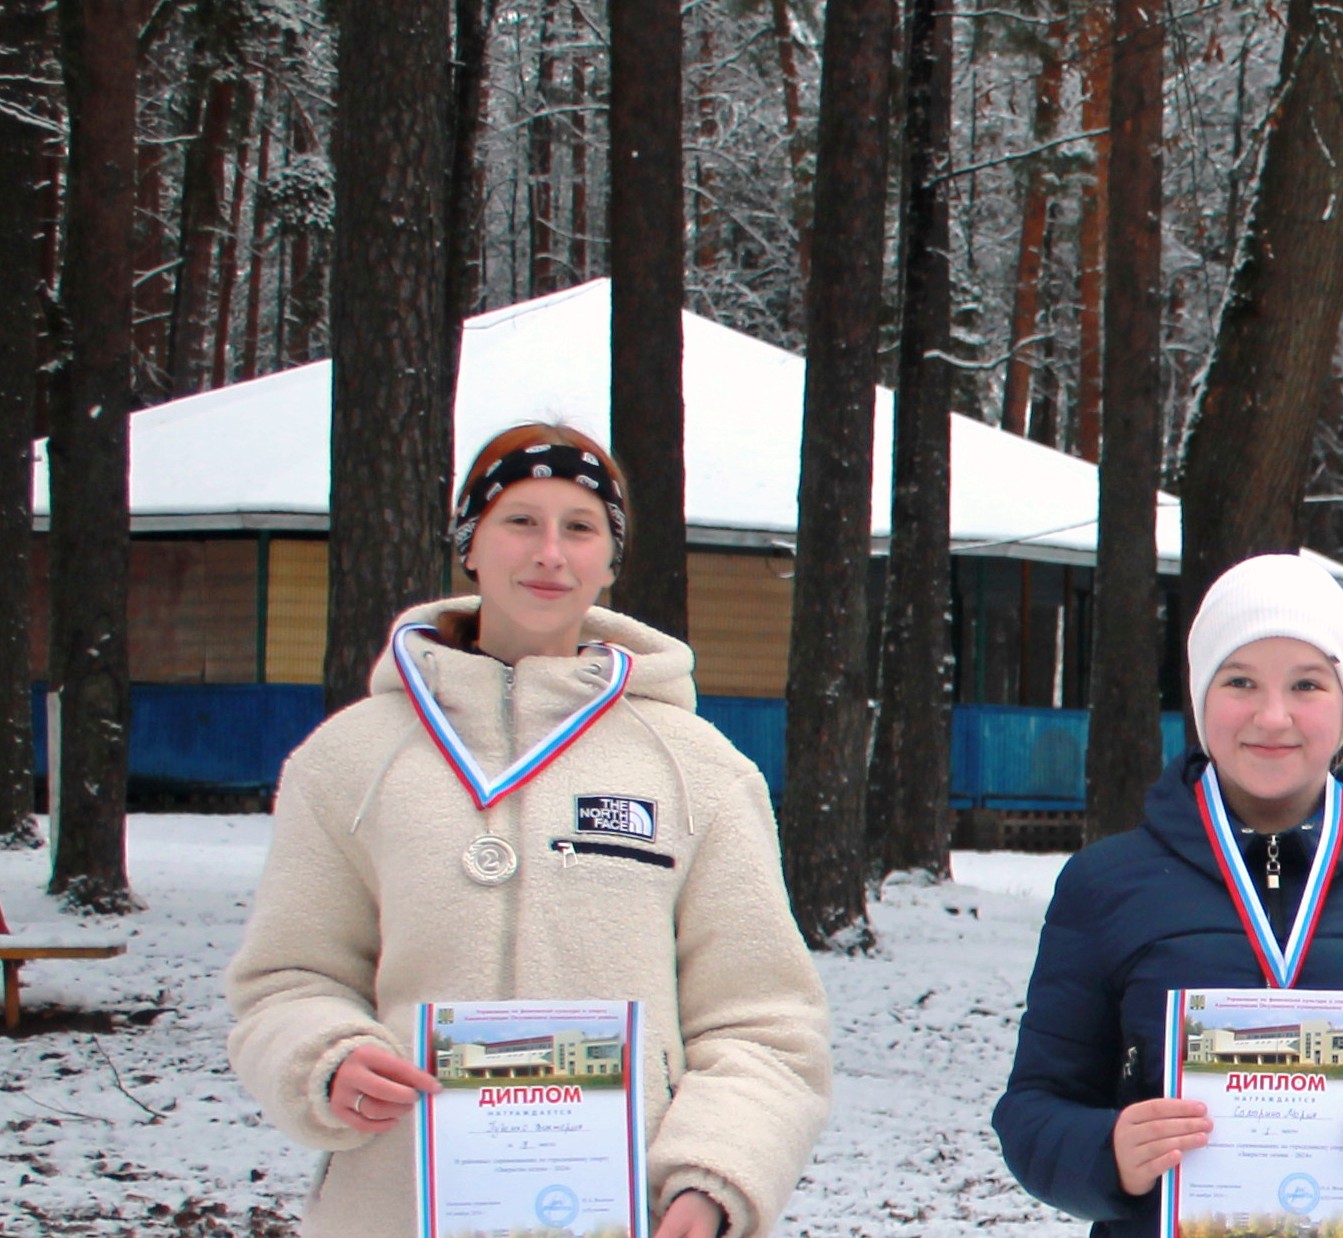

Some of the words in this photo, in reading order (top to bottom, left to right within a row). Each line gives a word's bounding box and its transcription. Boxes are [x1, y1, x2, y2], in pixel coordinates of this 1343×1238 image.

[600, 798, 629, 811] THE
[580, 807, 629, 821] NORTH
[593, 818, 629, 832] FACE
[1226, 1074, 1325, 1092] ДИПЛОМ
[479, 1087, 582, 1108] ДИПЛОМ
